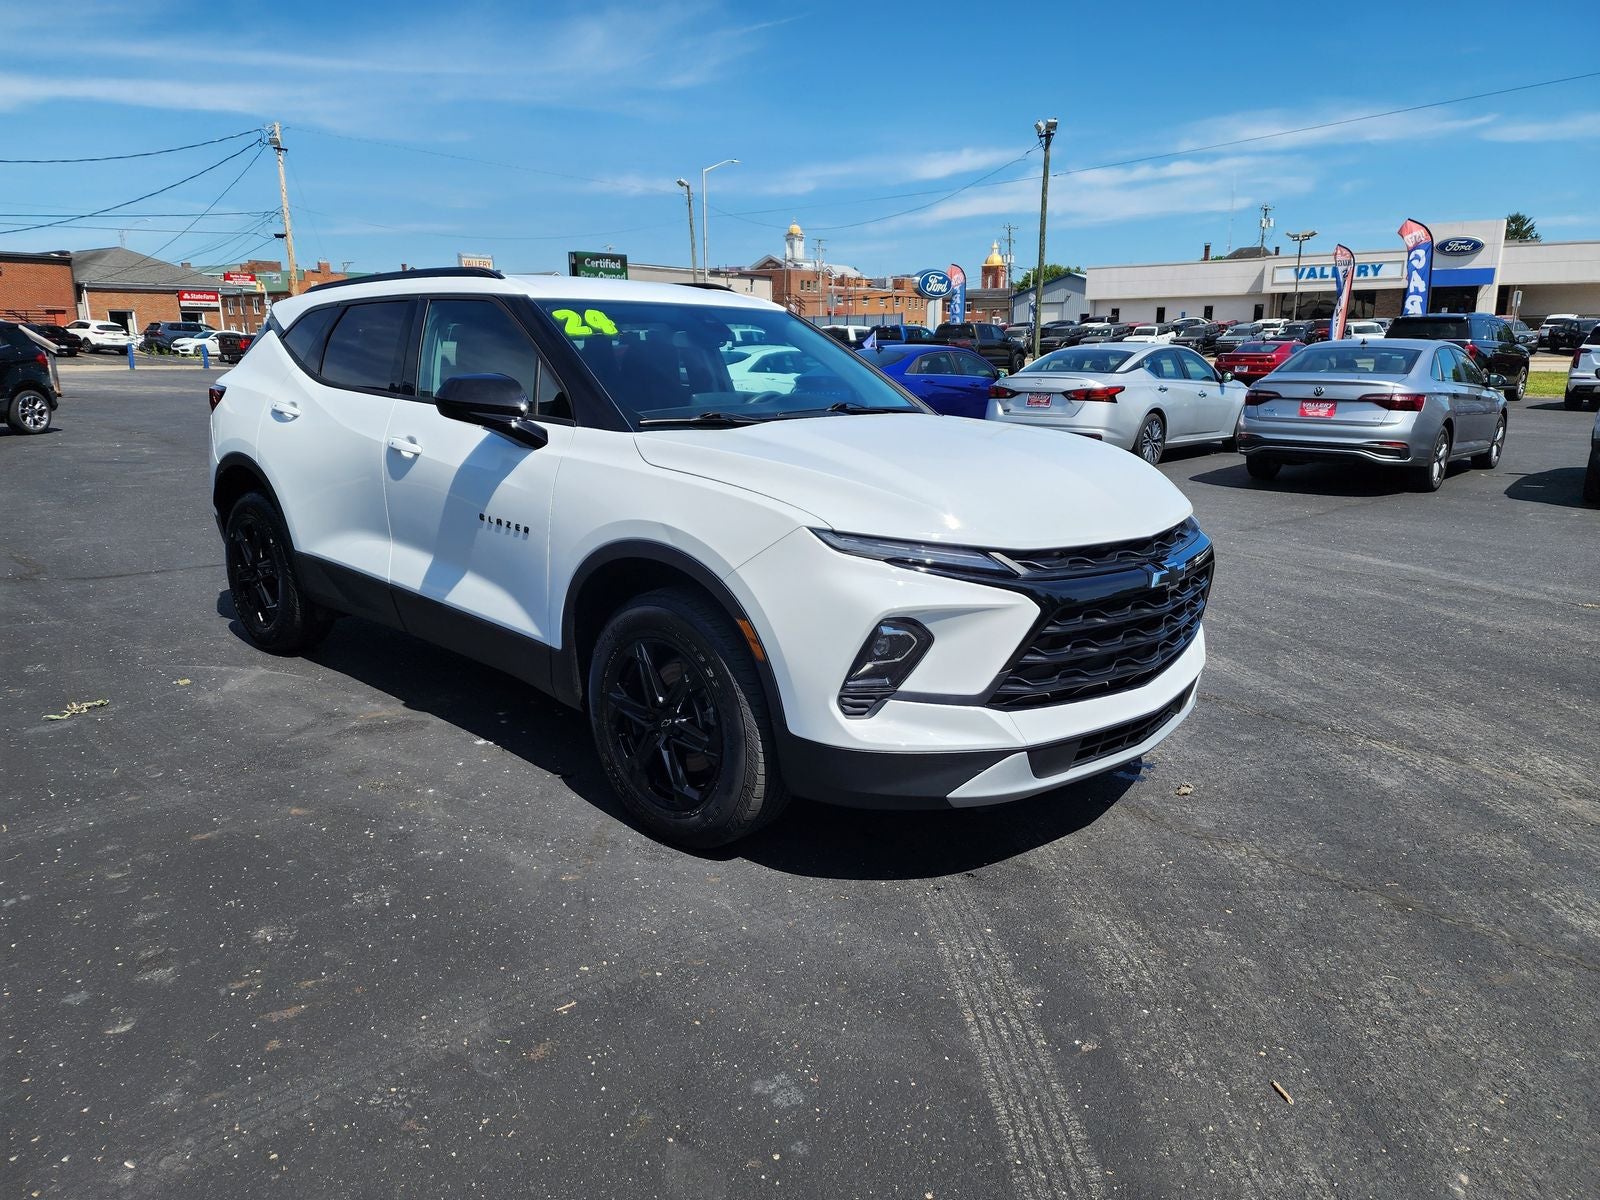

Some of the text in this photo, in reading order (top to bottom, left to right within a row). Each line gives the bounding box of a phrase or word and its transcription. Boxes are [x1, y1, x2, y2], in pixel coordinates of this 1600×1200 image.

[1445, 239, 1474, 252] Ford
[584, 257, 621, 270] Certified
[580, 270, 626, 280] Pre-Owned
[926, 274, 948, 293] Ford
[551, 308, 619, 336] 24
[1302, 402, 1334, 410] VALLERY
[478, 512, 530, 535] BLAZER
